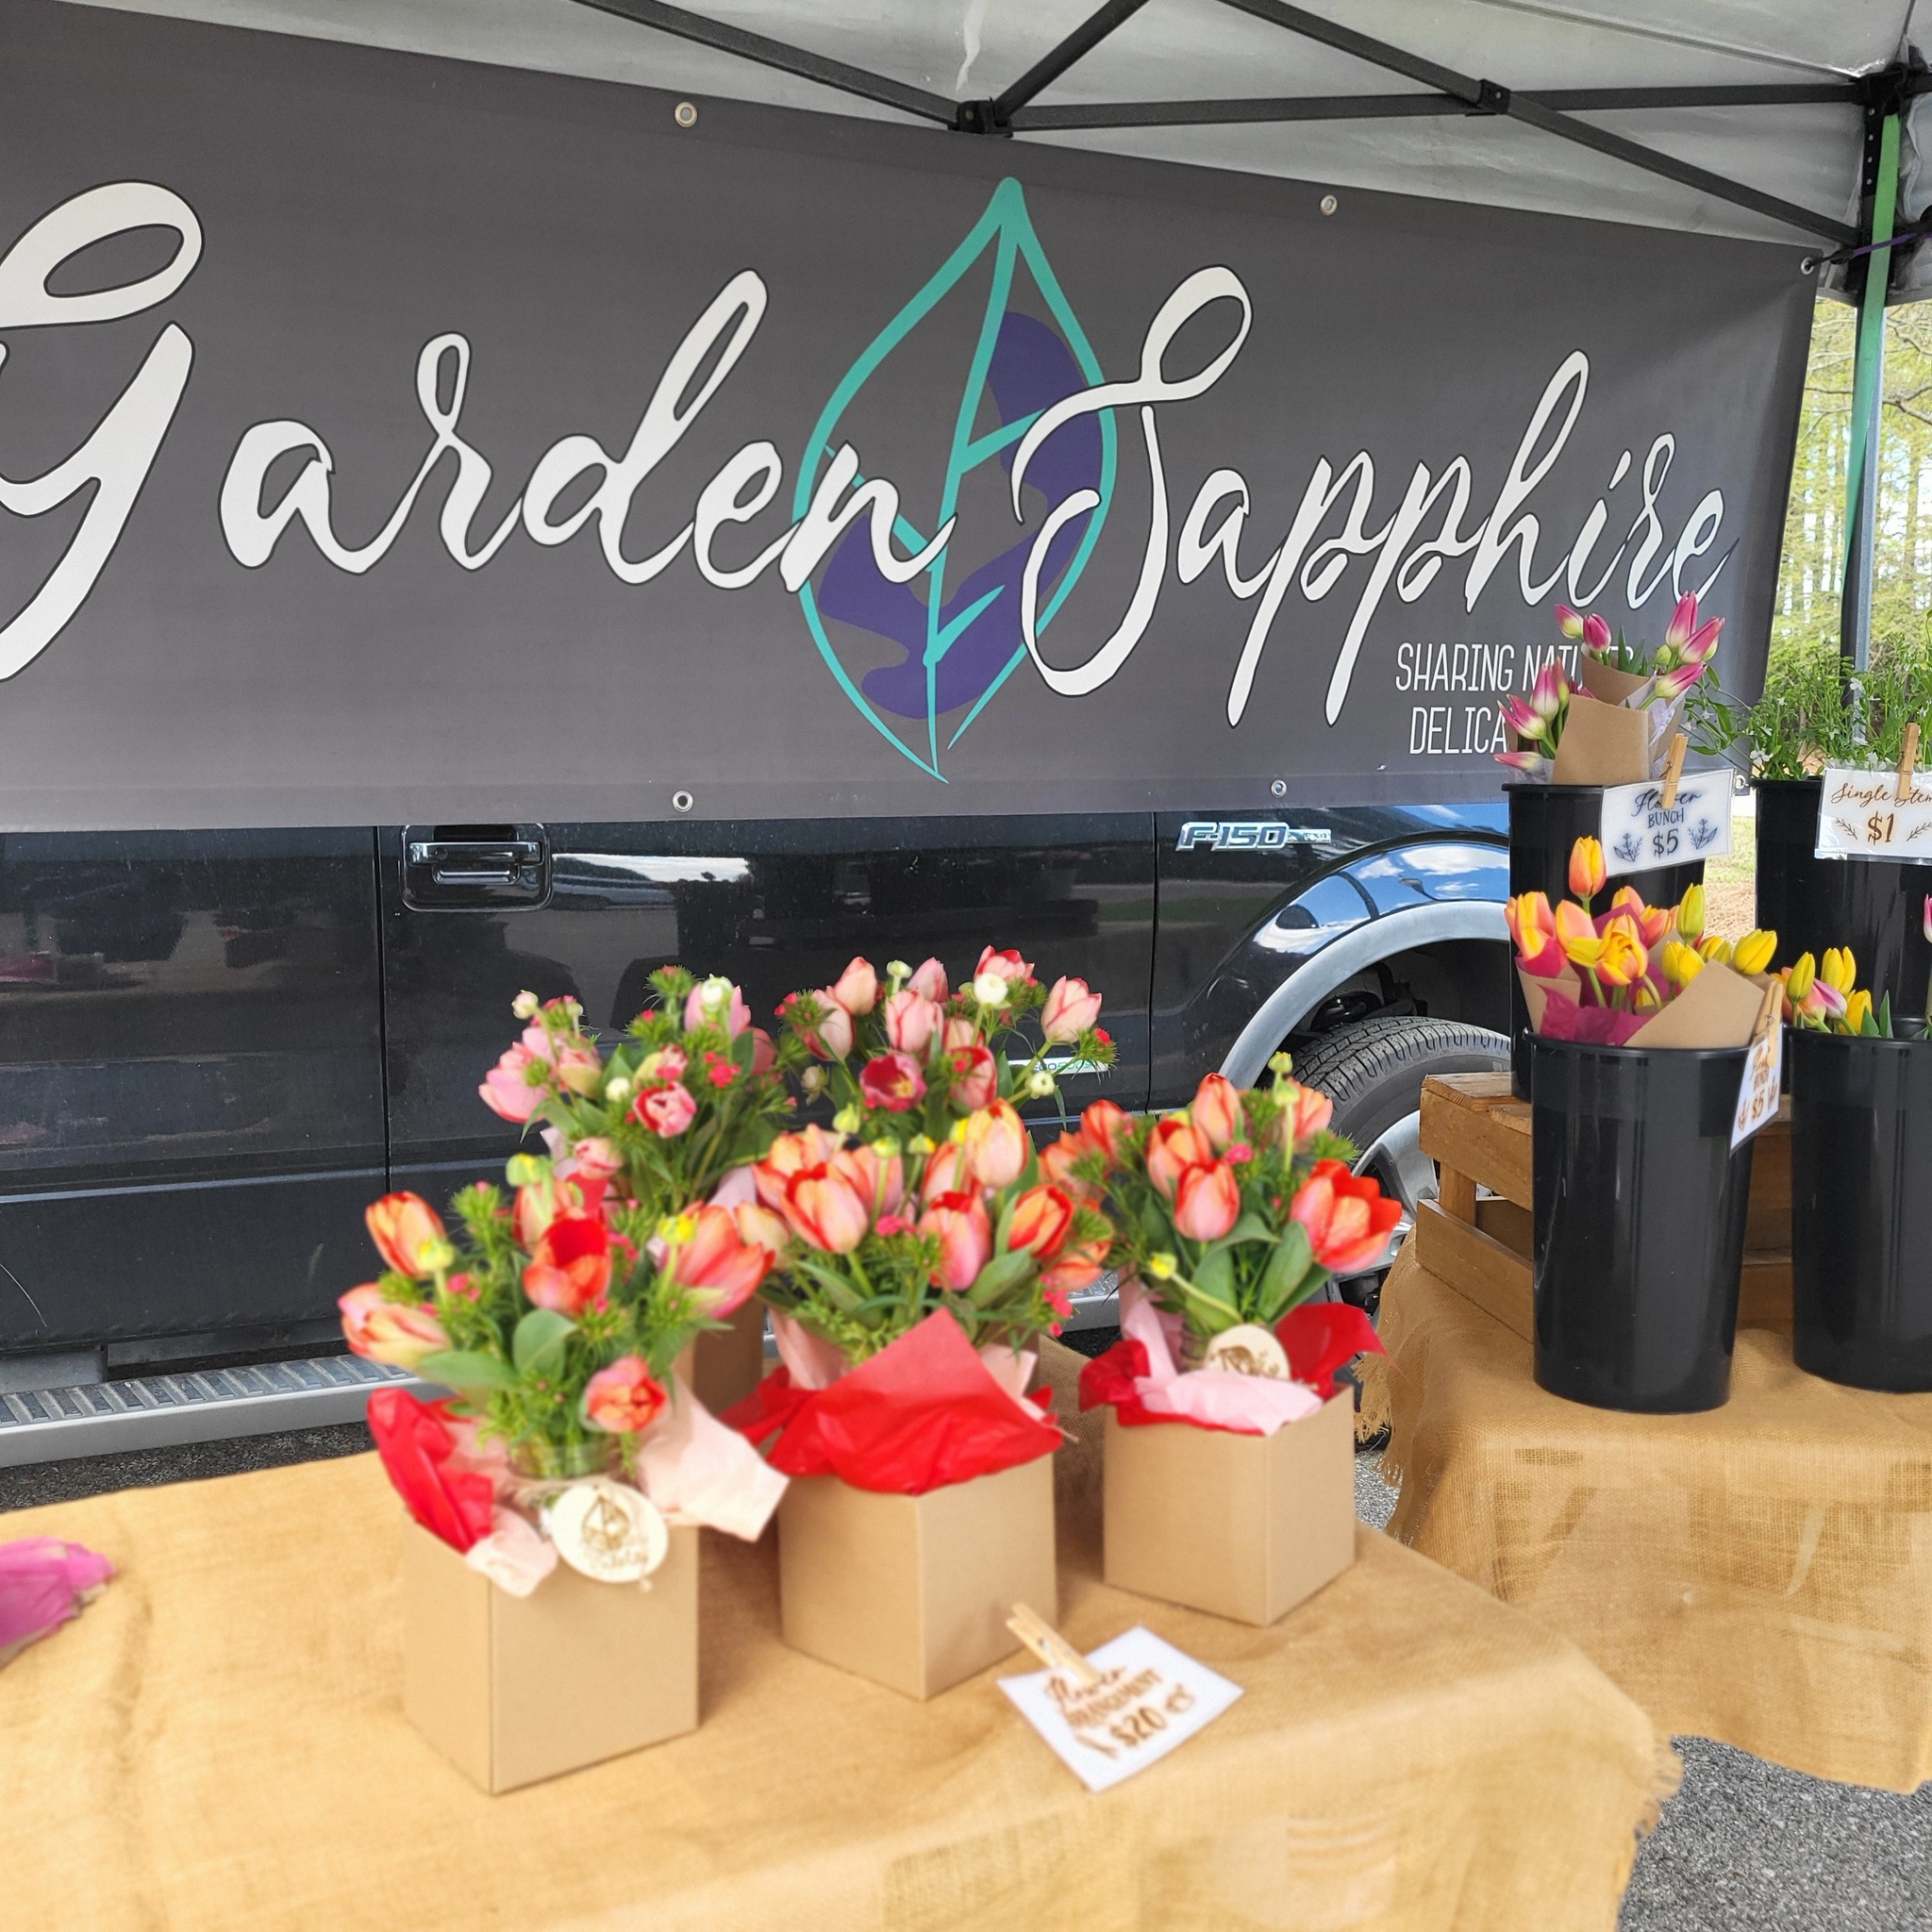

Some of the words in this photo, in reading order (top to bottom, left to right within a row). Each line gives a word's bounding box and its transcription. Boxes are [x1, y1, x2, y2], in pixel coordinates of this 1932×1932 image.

[0, 180, 956, 680] Garden
[1010, 265, 1740, 728] Sapphire
[1395, 642, 1515, 692] SHARING
[1522, 644, 1635, 692] NATU
[1409, 707, 1507, 755] DELICA
[1631, 789, 1703, 817] Floer
[1831, 783, 1891, 808] Single
[1647, 808, 1685, 828] BUNCH
[1868, 811, 1894, 845] $1
[1176, 823, 1290, 851] F-150
[1653, 828, 1679, 858] $5
